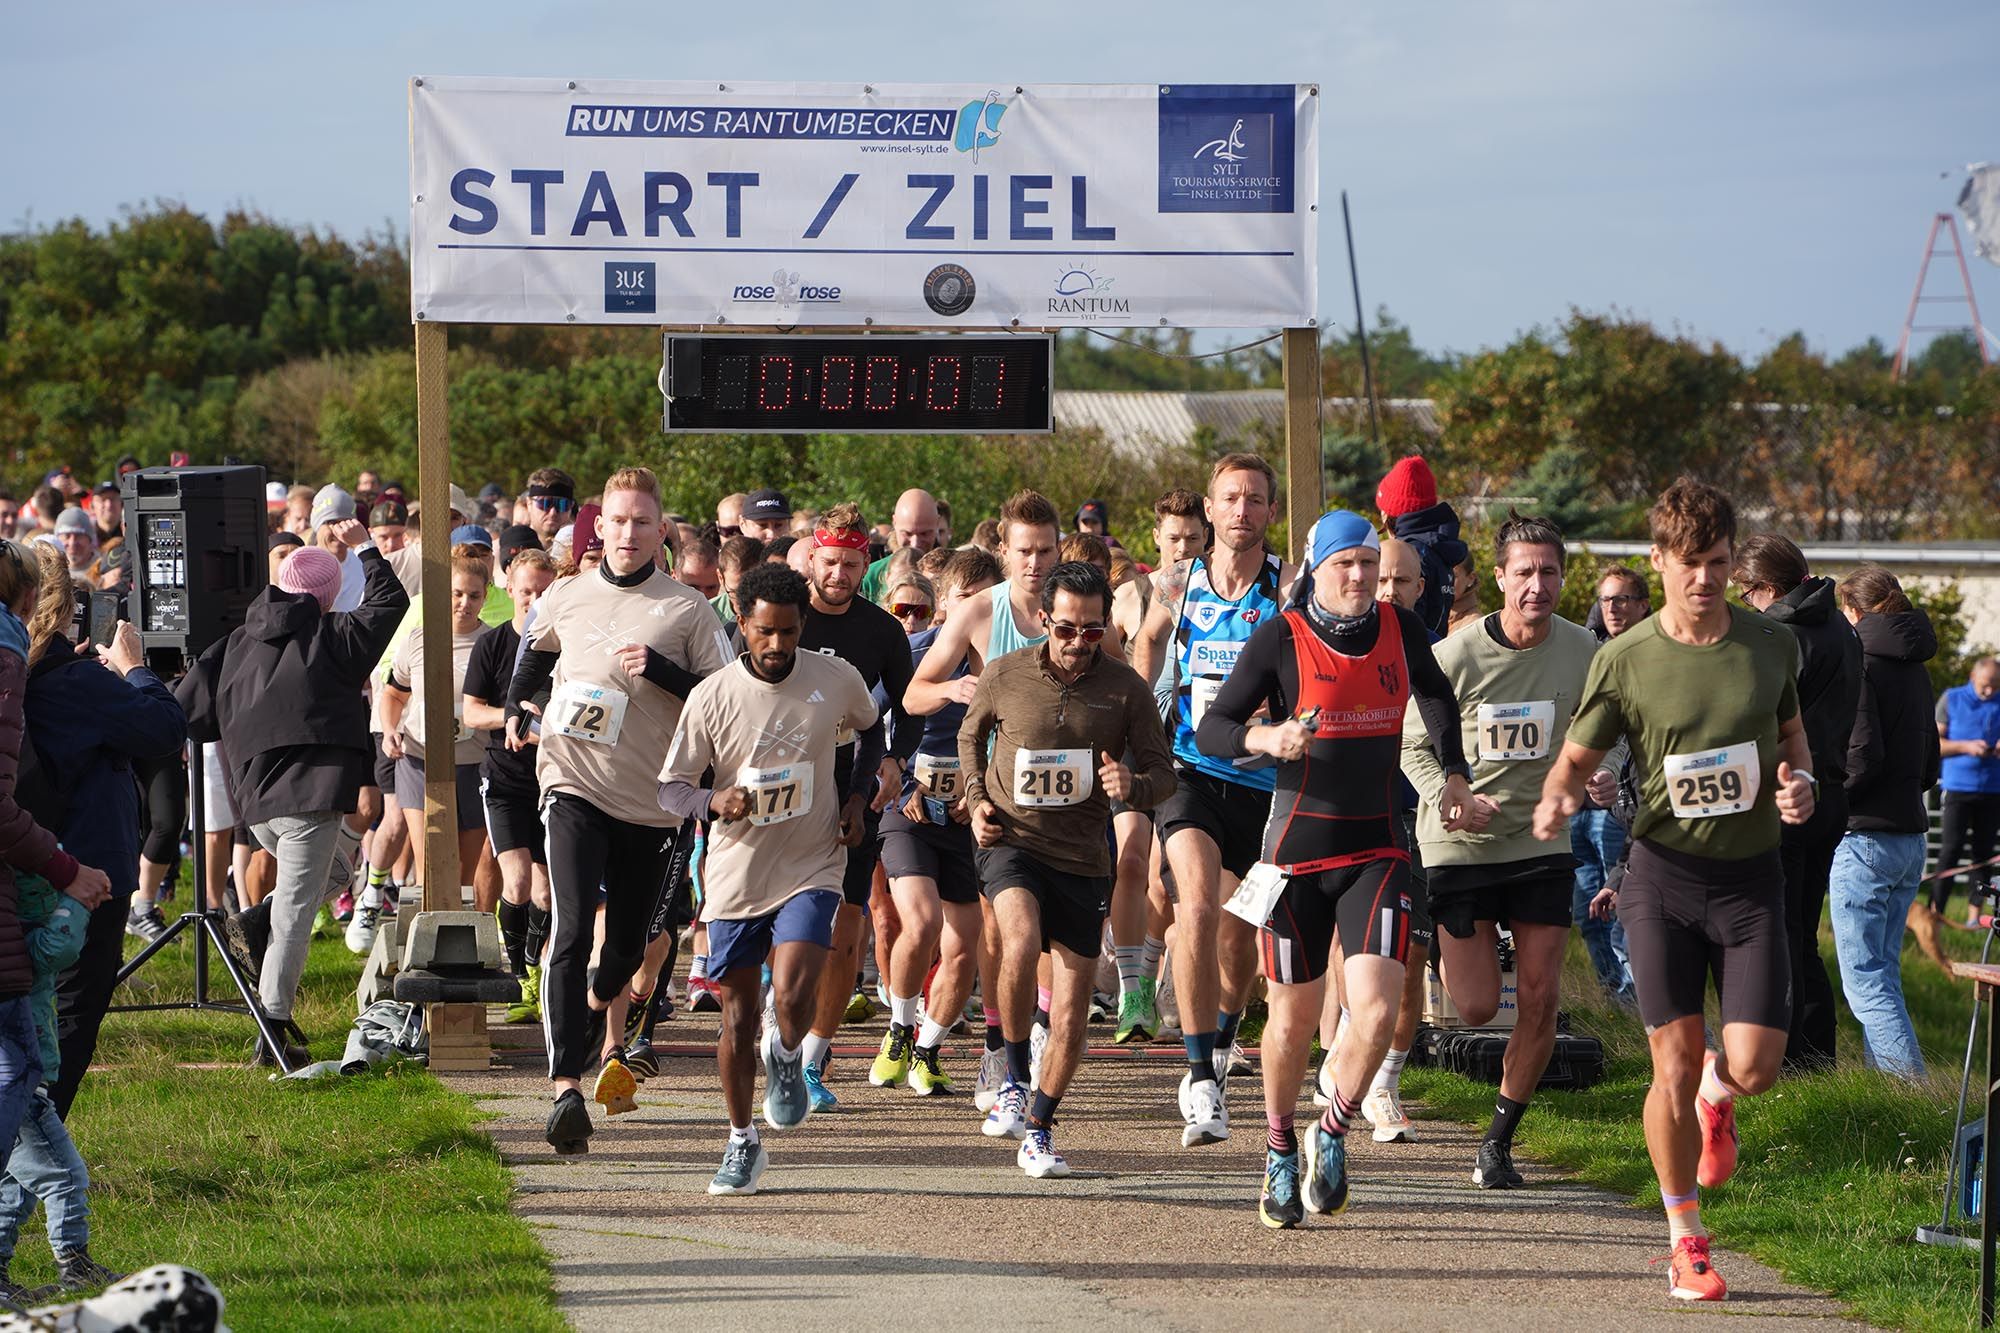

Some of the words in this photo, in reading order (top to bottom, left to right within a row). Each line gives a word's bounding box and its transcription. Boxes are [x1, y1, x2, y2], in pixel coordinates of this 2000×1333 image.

[572, 108, 635, 132] RUN
[643, 110, 706, 133] UMS
[714, 111, 950, 136] RANTUMBECKEN
[860, 144, 949, 154] www.insel-sylt.de
[1213, 163, 1242, 176] SYLT
[1173, 177, 1281, 187] TOURISMUS-SERVICE
[1191, 190, 1263, 199] INSEL-SYLT.DE
[448, 168, 759, 239] START
[802, 173, 860, 239] /
[906, 174, 1116, 241] ZIEL
[733, 285, 776, 299] rose
[799, 286, 841, 300] rose
[1047, 297, 1130, 313] RANTUM
[1486, 722, 1539, 750] 170
[928, 772, 956, 793] 15
[1020, 769, 1074, 796] 218
[1677, 770, 1742, 806] 259
[665, 852, 683, 900] BONN
